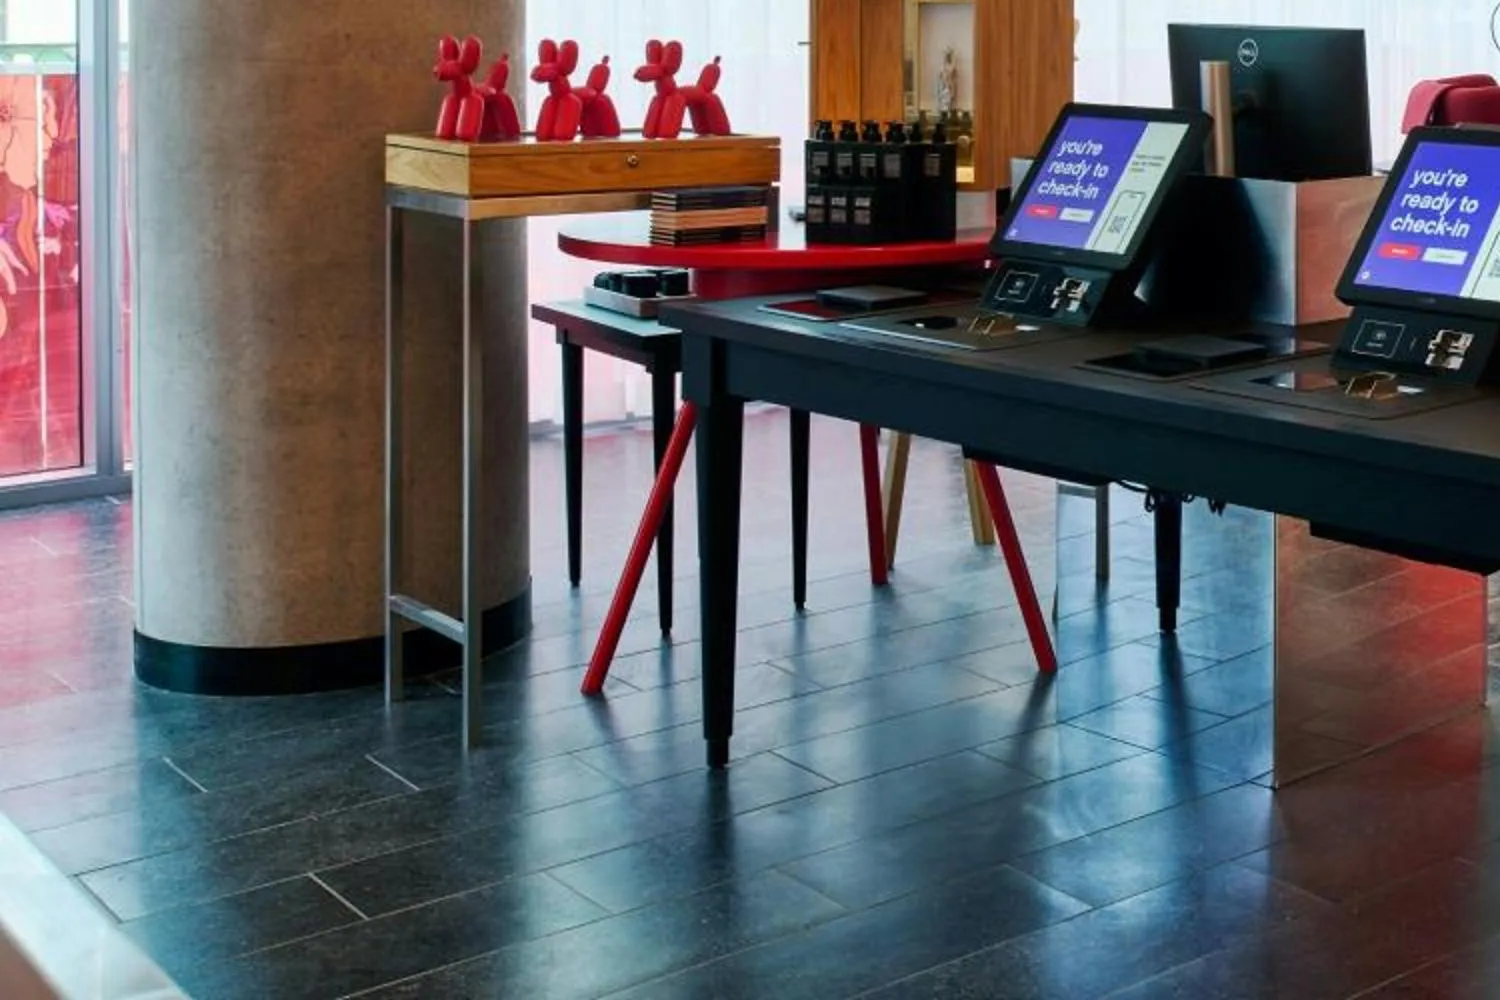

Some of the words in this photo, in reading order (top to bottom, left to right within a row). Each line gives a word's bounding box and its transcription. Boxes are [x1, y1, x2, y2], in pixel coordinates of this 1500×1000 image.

[1056, 139, 1103, 157] you're
[1047, 160, 1092, 181] ready
[1093, 163, 1109, 178] to
[1408, 169, 1468, 189] you're
[1037, 178, 1099, 199] check-in
[1400, 192, 1457, 216] ready
[1459, 196, 1479, 214] to
[1390, 212, 1471, 239] check-in
